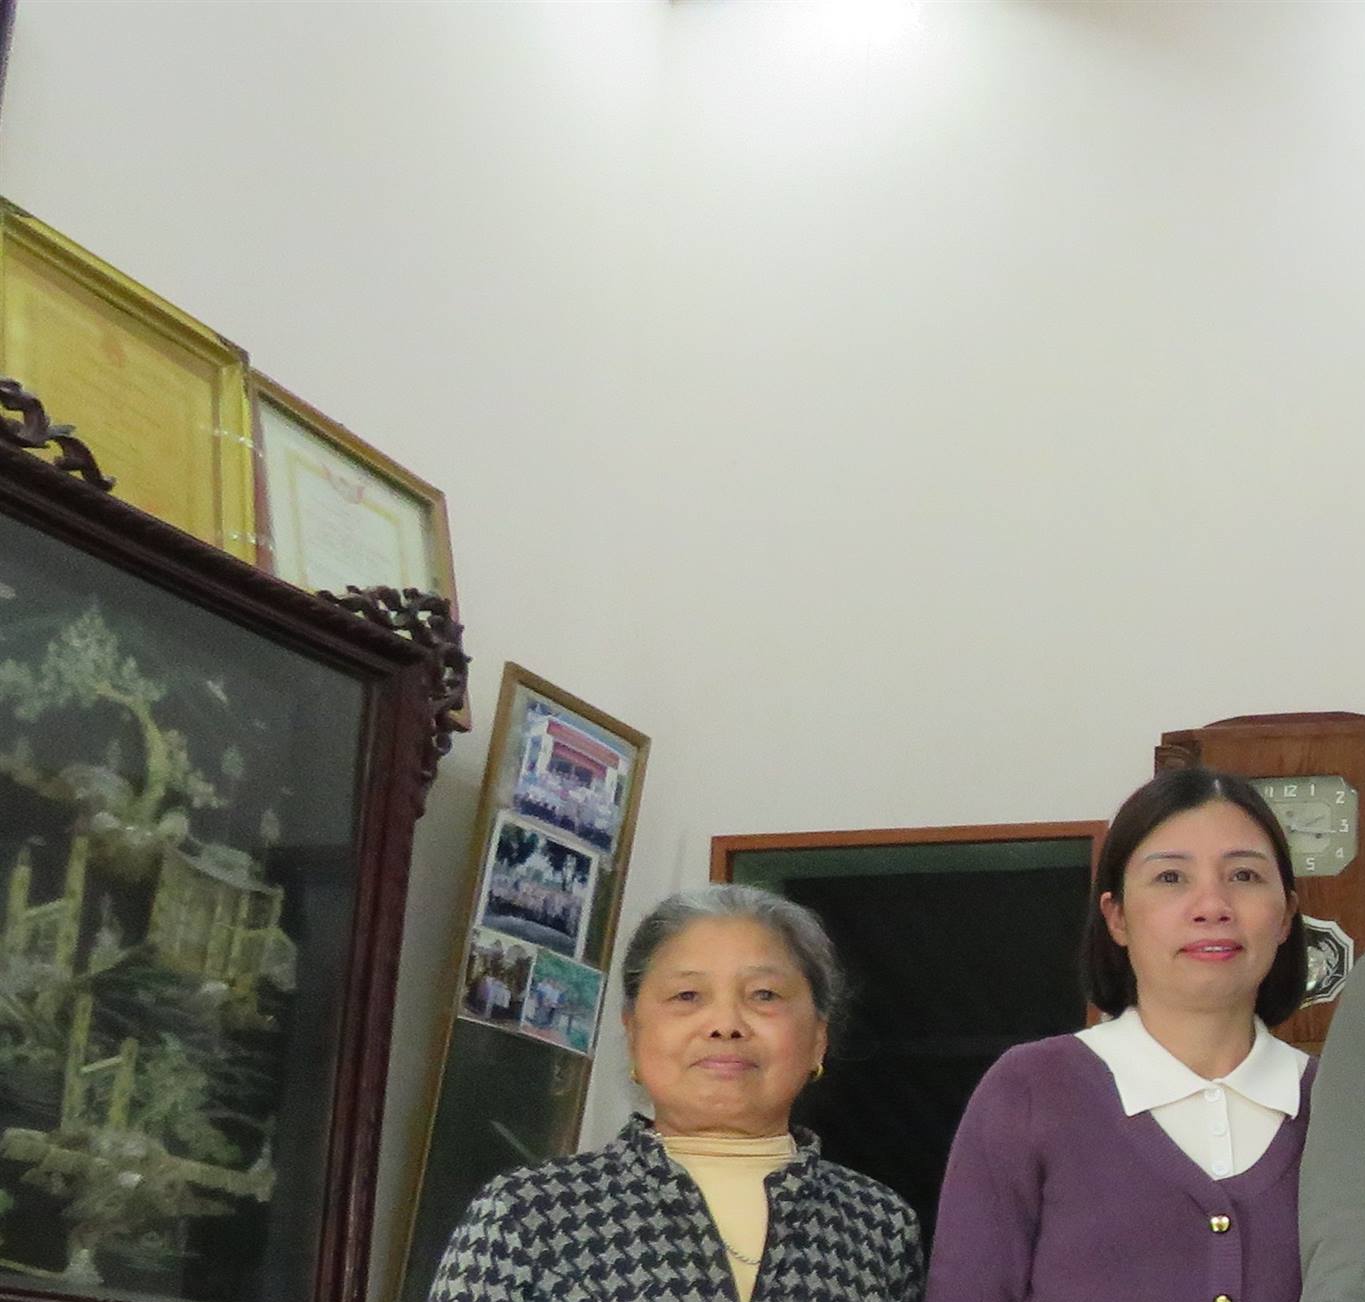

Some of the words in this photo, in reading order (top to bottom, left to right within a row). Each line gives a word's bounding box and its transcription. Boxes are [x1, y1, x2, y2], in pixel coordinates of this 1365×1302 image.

[1284, 784, 1298, 798] 12
[1310, 783, 1316, 796] 1
[1335, 790, 1345, 804] 2
[1339, 818, 1349, 833] 3
[1335, 847, 1345, 859] 4
[1306, 857, 1316, 871] 5
